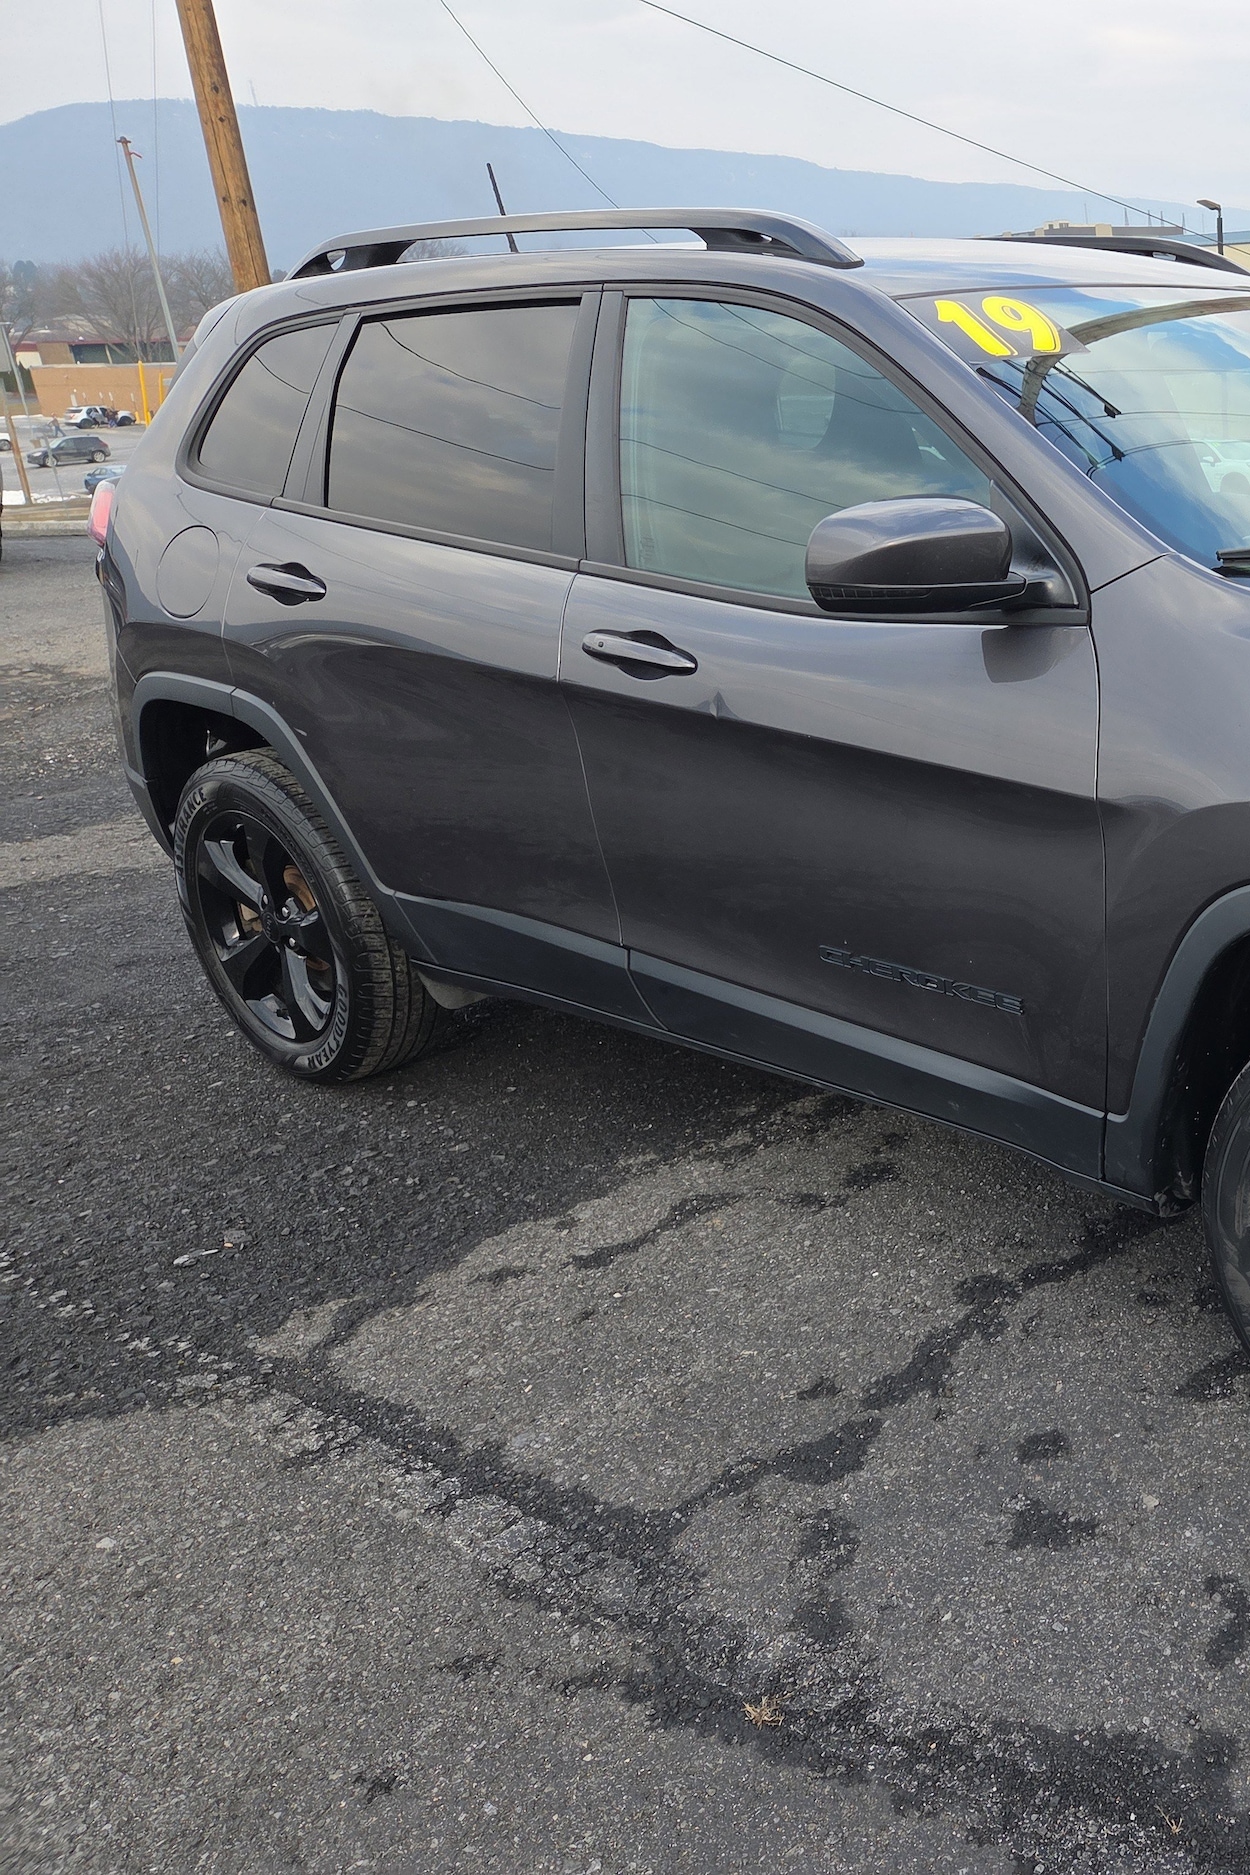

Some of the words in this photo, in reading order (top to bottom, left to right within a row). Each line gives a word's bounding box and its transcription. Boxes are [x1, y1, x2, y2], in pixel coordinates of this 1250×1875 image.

[934, 296, 1062, 357] 19
[174, 786, 207, 879] ASSURANCE
[818, 944, 1025, 1016] CHEROKEE
[306, 983, 348, 1070] GOODYEAR
